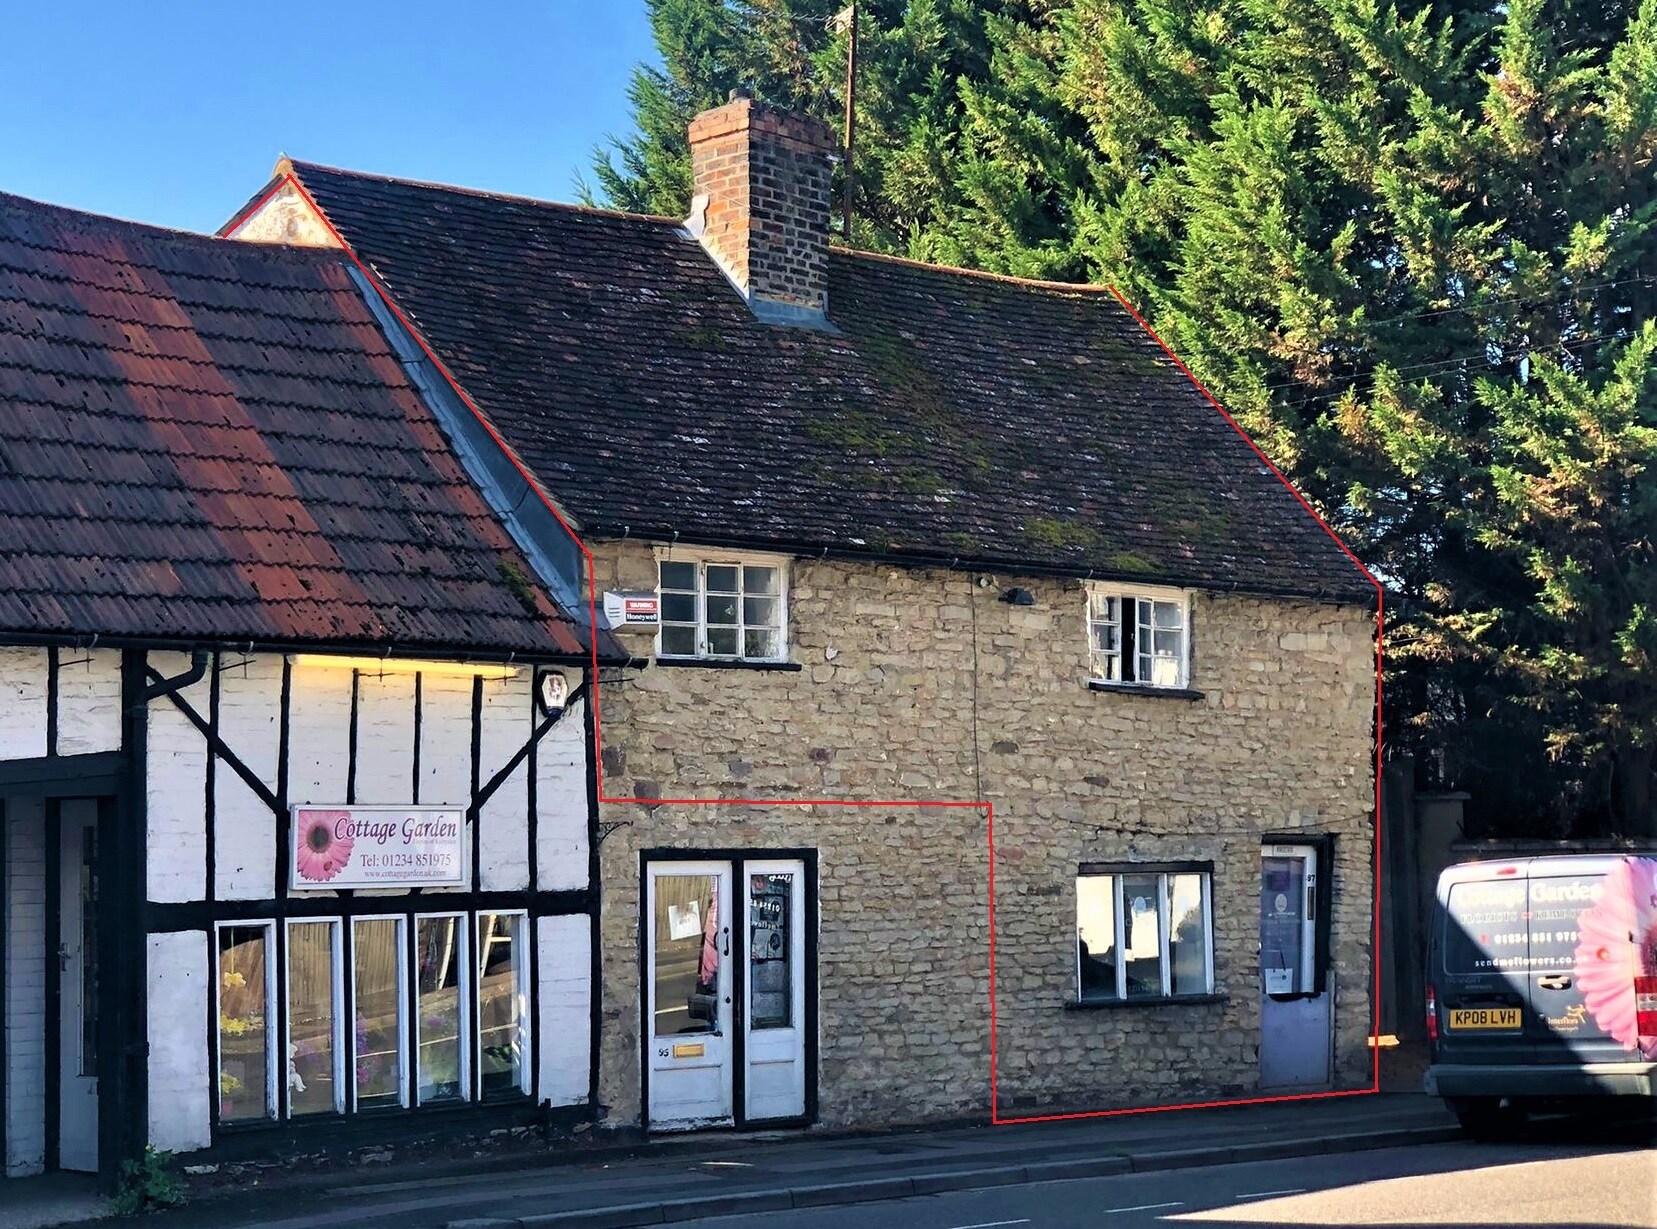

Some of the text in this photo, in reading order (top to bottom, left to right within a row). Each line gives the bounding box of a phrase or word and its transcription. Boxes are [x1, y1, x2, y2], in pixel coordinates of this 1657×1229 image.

[334, 815, 457, 845] Cottage Garden
[360, 853, 451, 867] Tel: 01234 851975
[1533, 881, 1603, 902] Garden
[1532, 933, 1551, 943] 851
[1556, 932, 1578, 942] 975
[1475, 956, 1588, 967] sendmeflowers.co.
[1455, 1010, 1516, 1025] KP08 LVH
